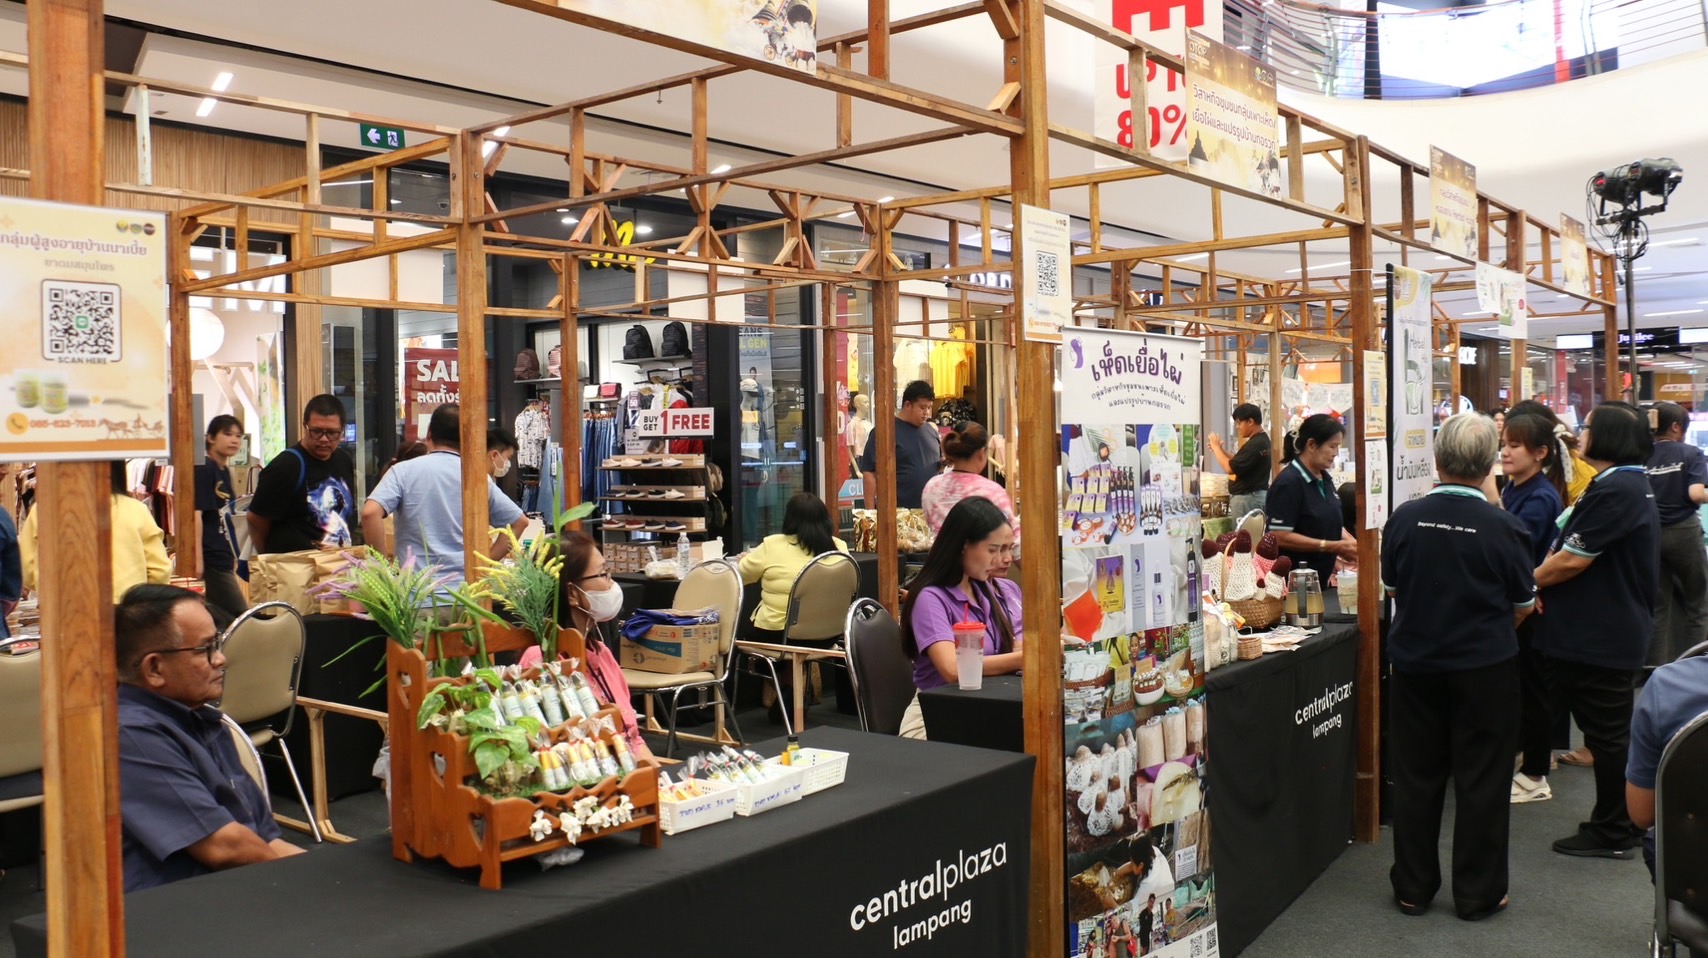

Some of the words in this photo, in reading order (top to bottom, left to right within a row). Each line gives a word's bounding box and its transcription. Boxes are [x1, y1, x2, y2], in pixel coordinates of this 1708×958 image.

[1617, 332, 1655, 344] Juilee
[58, 356, 84, 364] SCAN
[85, 356, 108, 365] HERE
[1091, 338, 1184, 384] เห็ดเยื่อไผ่
[643, 415, 659, 423] BUY
[660, 410, 668, 434] 1
[672, 414, 710, 430] FREE
[1312, 713, 1342, 739] lampang
[850, 841, 1007, 931] centralplaza
[893, 899, 972, 950] lampang
